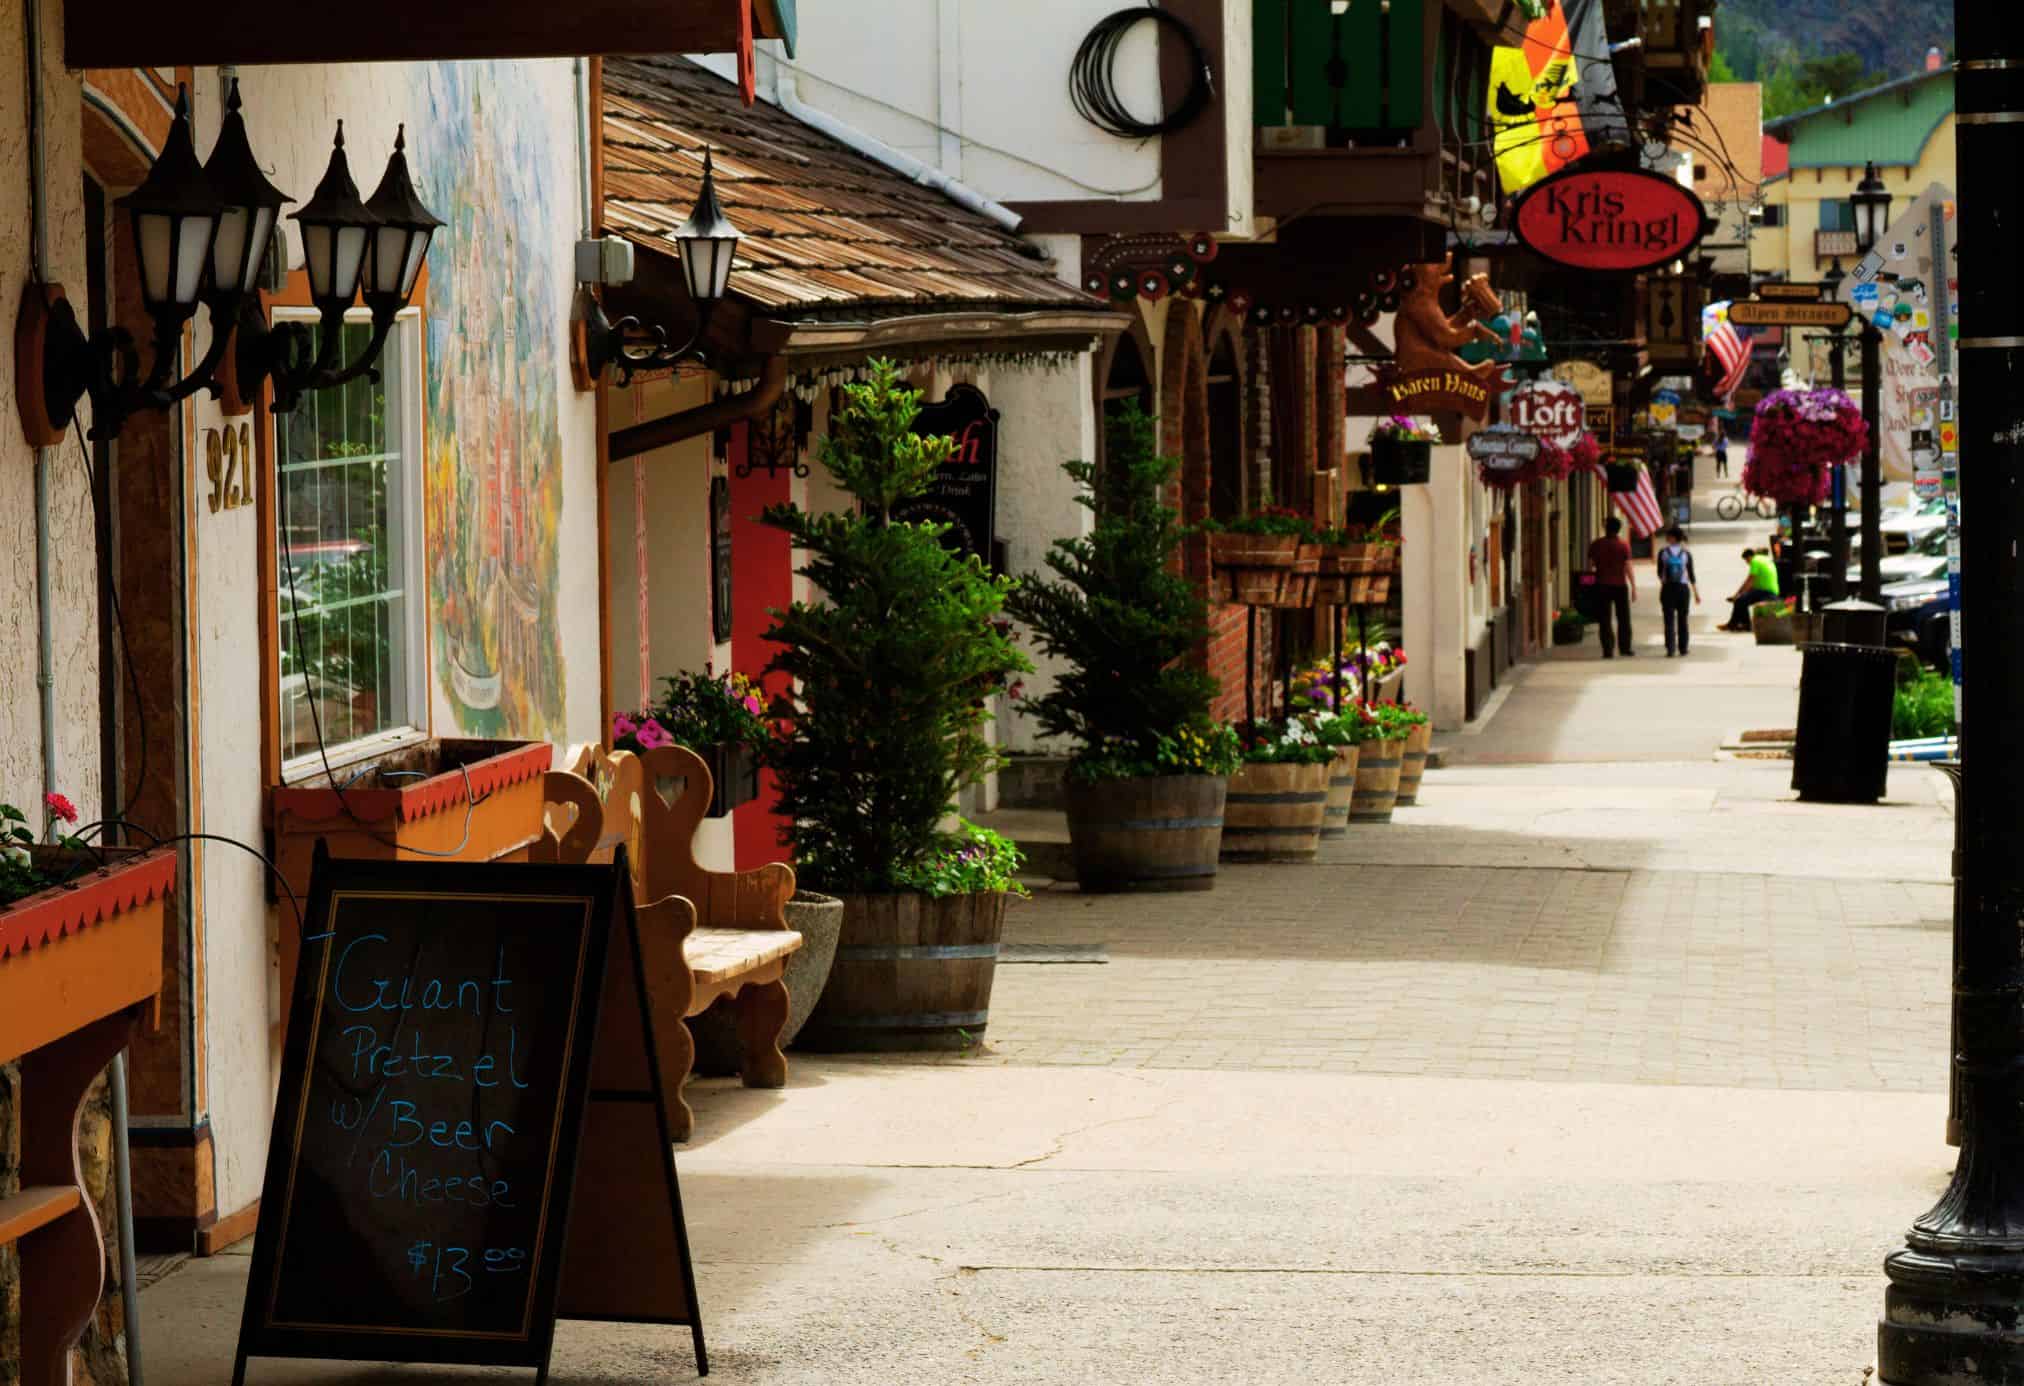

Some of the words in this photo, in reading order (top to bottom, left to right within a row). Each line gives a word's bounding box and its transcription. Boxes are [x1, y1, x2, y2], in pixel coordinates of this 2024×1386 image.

[1547, 183, 1625, 216] Kris
[1560, 212, 1679, 250] Kringl
[1519, 400, 1577, 426] Loft
[205, 422, 253, 514] 921
[334, 933, 513, 1016] Giant
[343, 1024, 529, 1089] Pretzel
[387, 1099, 515, 1152] Beer
[368, 1149, 517, 1208] Cheese
